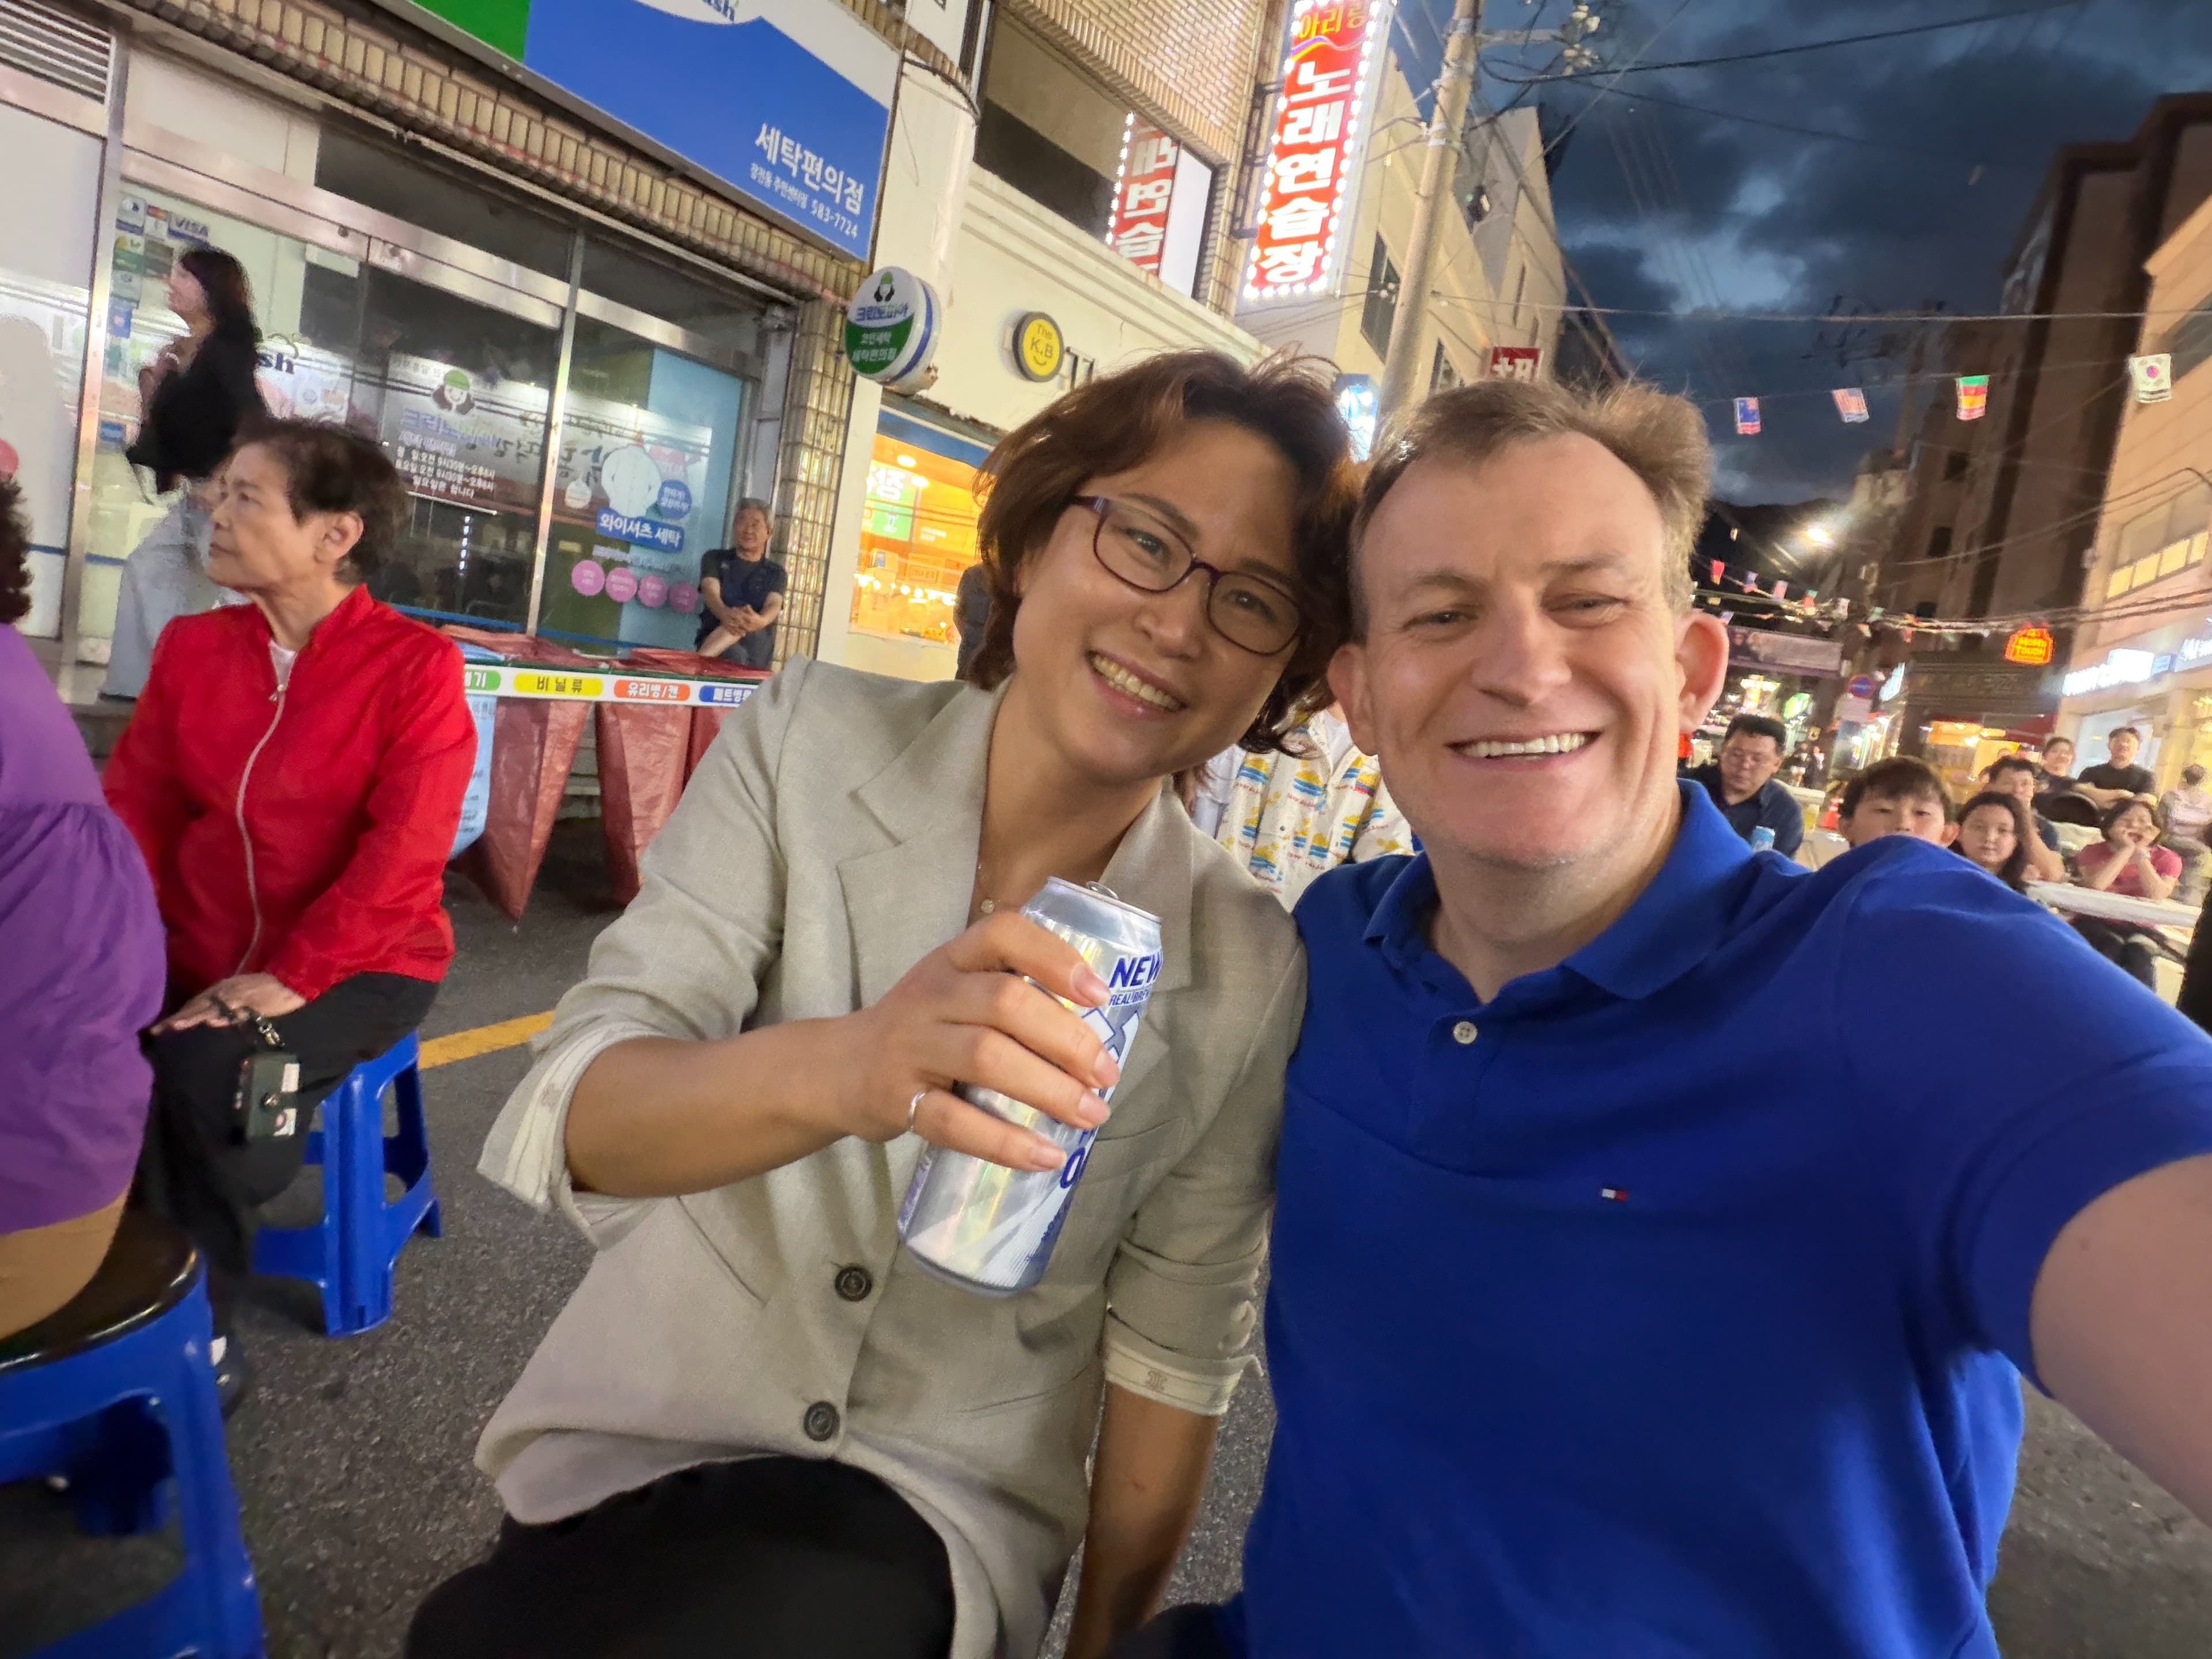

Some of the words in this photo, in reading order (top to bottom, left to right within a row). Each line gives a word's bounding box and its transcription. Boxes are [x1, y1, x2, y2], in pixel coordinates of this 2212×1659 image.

[1298, 0, 1366, 39] 아리랑
[755, 123, 864, 216] 세탁편의점
[1260, 60, 1351, 284] 노래연습장
[175, 217, 210, 237] VISA
[811, 199, 858, 240] 583-7724
[1037, 323, 1054, 340] The
[599, 513, 653, 539] 와이셔츠
[654, 526, 681, 547] 세탁
[628, 681, 679, 699] 유리병/캔
